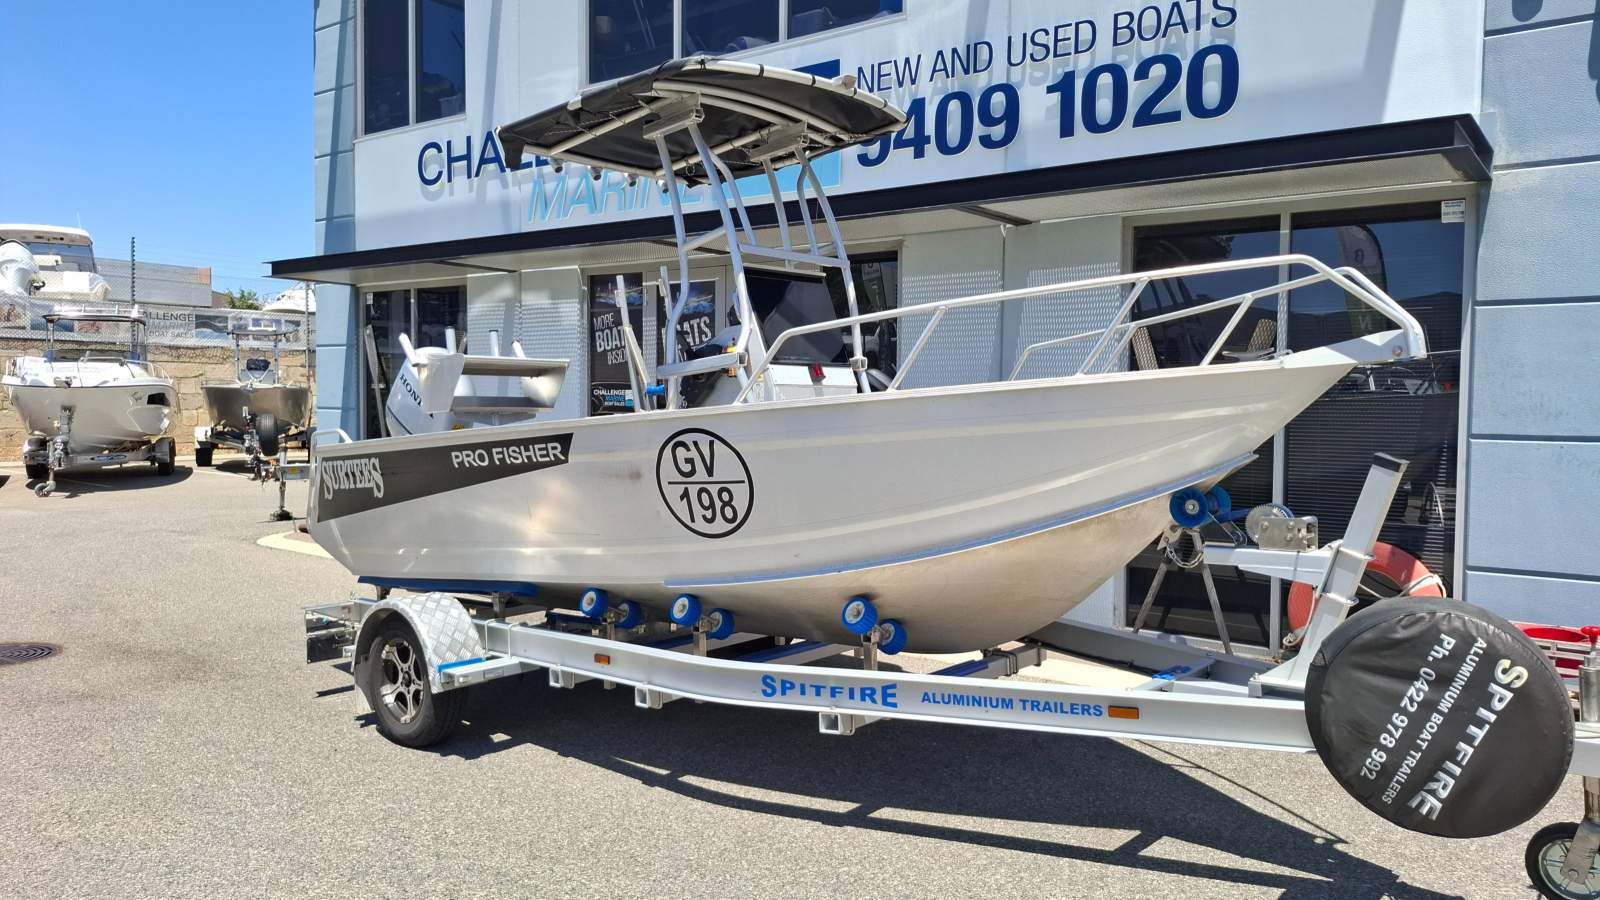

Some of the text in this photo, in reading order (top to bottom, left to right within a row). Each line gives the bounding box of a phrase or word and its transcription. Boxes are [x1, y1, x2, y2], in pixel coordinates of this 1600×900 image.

[857, 0, 1238, 93] NEW AND USED BOATS
[1046, 44, 1240, 140] 1020
[593, 312, 615, 331] MORE
[595, 326, 626, 353] BOAT
[607, 348, 627, 365] INSID
[593, 388, 625, 396] CHALLENGE
[451, 442, 565, 469] PRO FISHER
[670, 440, 715, 478] GV
[320, 457, 384, 500] SURTEES
[679, 486, 738, 524] 198
[760, 674, 1104, 717] SPITFIRE ALUMINIUM TRAILERS
[1359, 633, 1456, 780] Ph. 0422 978 992
[1381, 636, 1487, 805] ALUMINIUM BOAT TRAILERS
[1407, 658, 1529, 821] SPITFIRE
